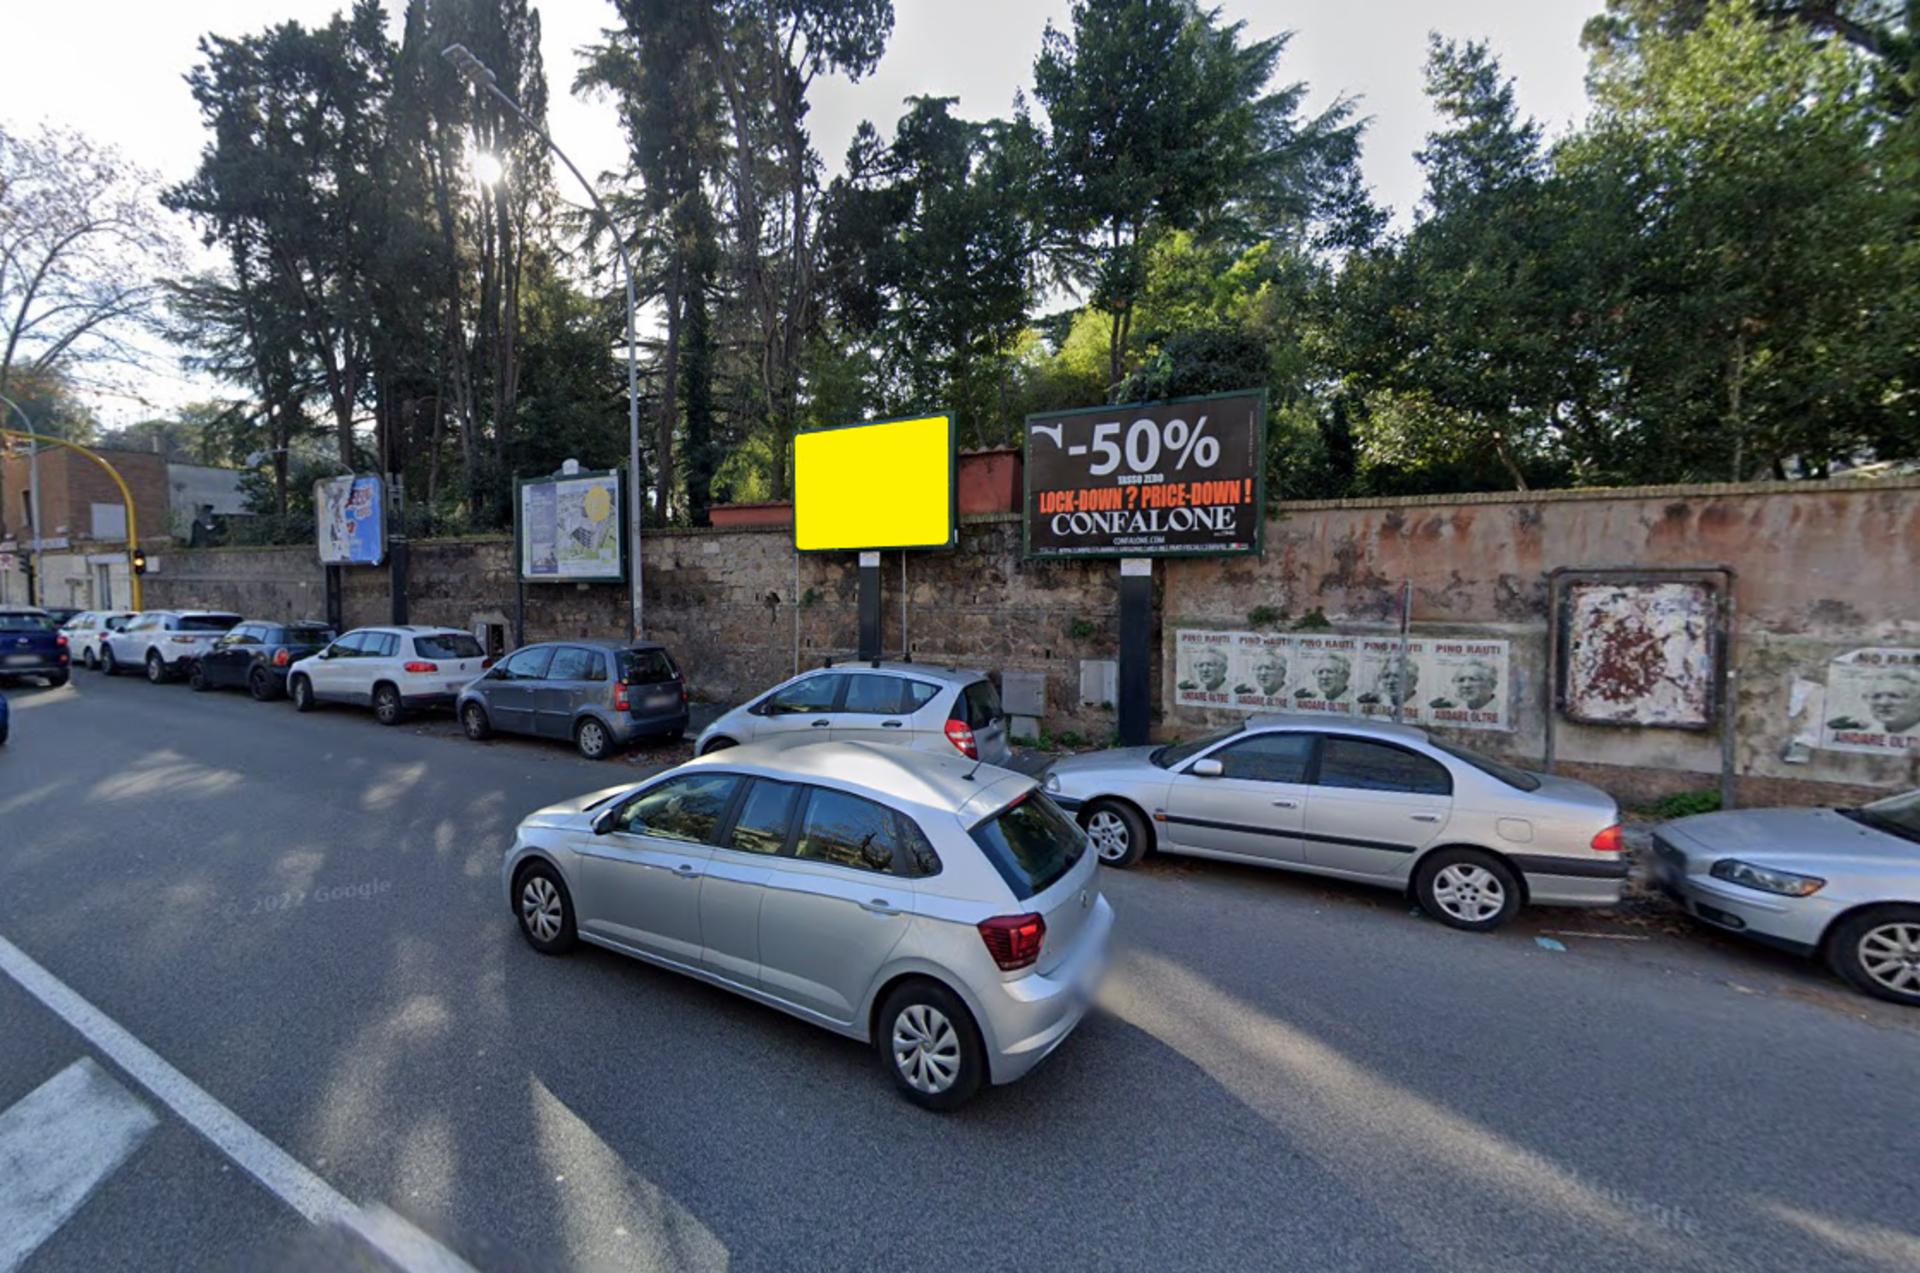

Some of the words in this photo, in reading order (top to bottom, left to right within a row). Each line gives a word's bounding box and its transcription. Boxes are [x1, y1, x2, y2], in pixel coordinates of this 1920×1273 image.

[1068, 416, 1220, 476] -50%
[1040, 487, 1122, 513] LOCK-DOWN
[1141, 480, 1240, 508] PRICE-DOWN
[1051, 506, 1236, 536] CONFALONE
[1436, 644, 1462, 654] PINO
[1467, 645, 1500, 655] RAUTI
[1435, 709, 1468, 722] ANDARE
[1471, 711, 1499, 724] OLTRE
